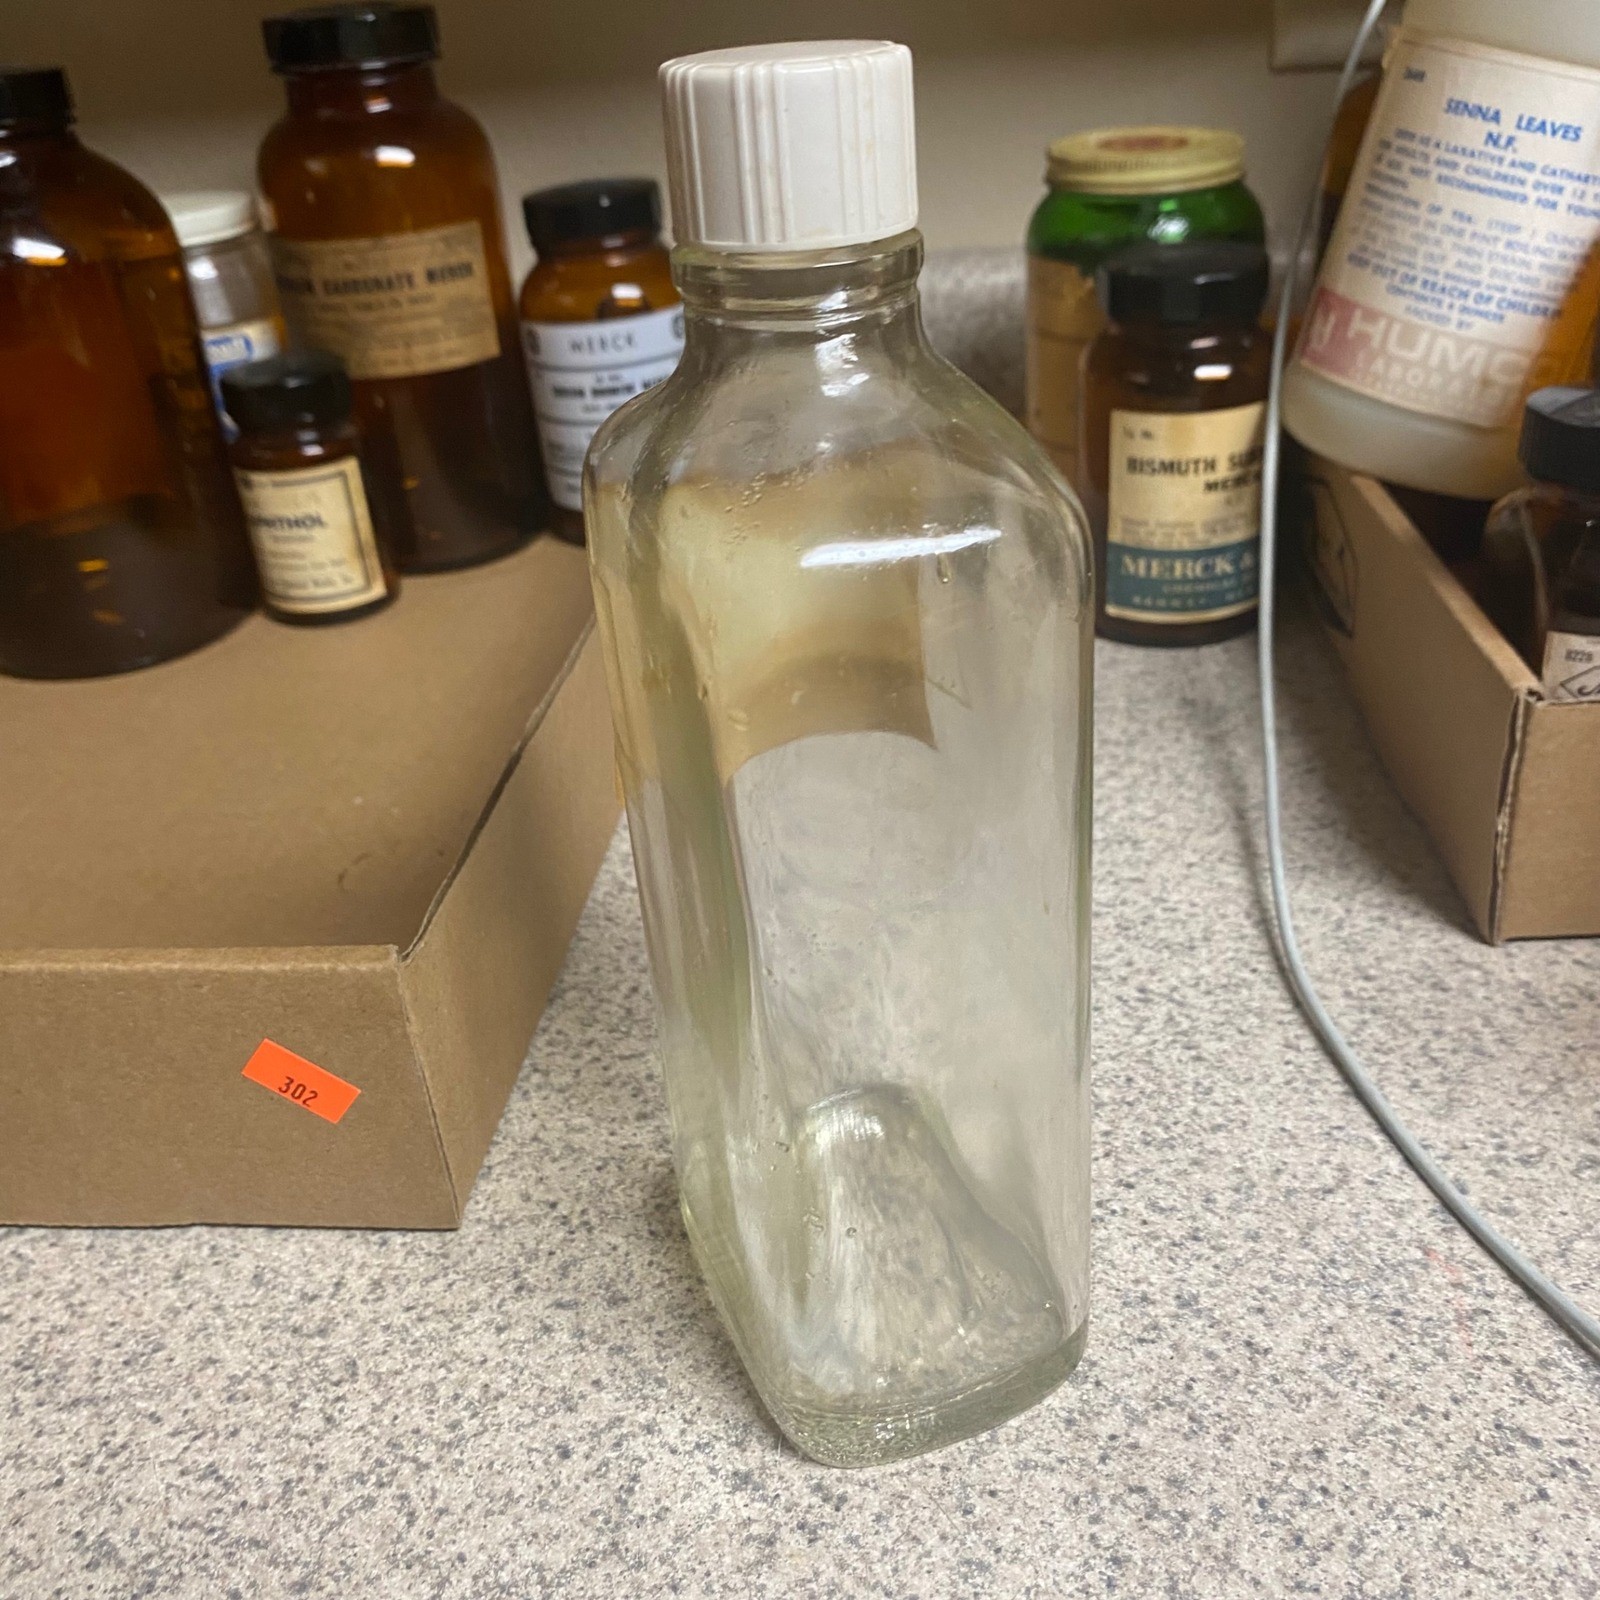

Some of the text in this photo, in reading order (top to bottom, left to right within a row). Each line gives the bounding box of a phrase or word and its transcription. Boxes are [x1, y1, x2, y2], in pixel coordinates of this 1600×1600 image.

[1444, 97, 1583, 143] SENNA LEAVES
[1444, 142, 1505, 166] LAXATIVE
[1508, 157, 1538, 173] AND
[1484, 130, 1519, 155] N.F.
[1434, 155, 1461, 172] AND
[1464, 163, 1529, 187] CHILDREN
[1531, 179, 1566, 196] OVER
[1435, 172, 1530, 204] RECOMMENDED
[1534, 196, 1560, 212] FOR
[1420, 276, 1471, 299] REACH
[1472, 291, 1495, 306] OF
[570, 332, 634, 353] MERCK
[1126, 455, 1217, 477] BISMUTH
[1120, 553, 1235, 580] MERCK
[278, 1076, 318, 1107] 302
